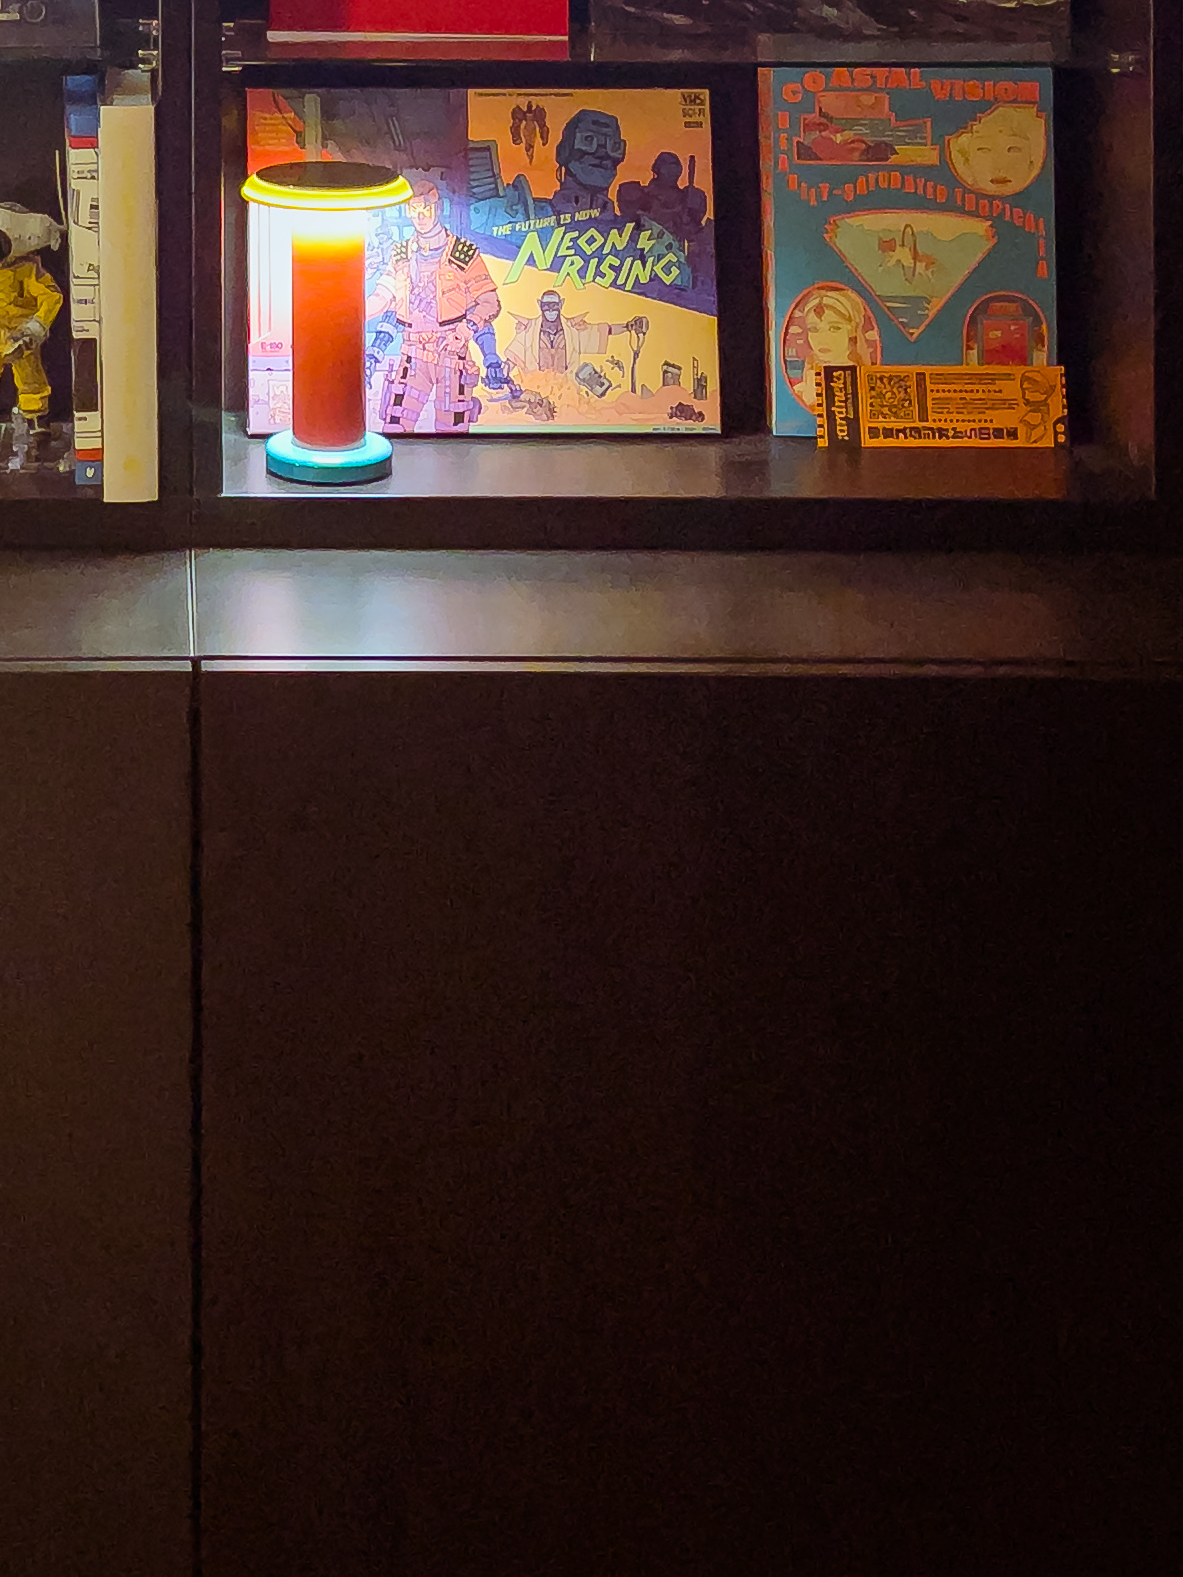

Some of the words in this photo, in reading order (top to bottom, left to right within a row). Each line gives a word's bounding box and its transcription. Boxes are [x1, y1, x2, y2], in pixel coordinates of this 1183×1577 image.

[781, 67, 926, 104] COASTAL
[930, 79, 1040, 102] VISION
[515, 215, 556, 232] FUTURE
[502, 221, 636, 286] NEON
[553, 251, 681, 291] RISING
